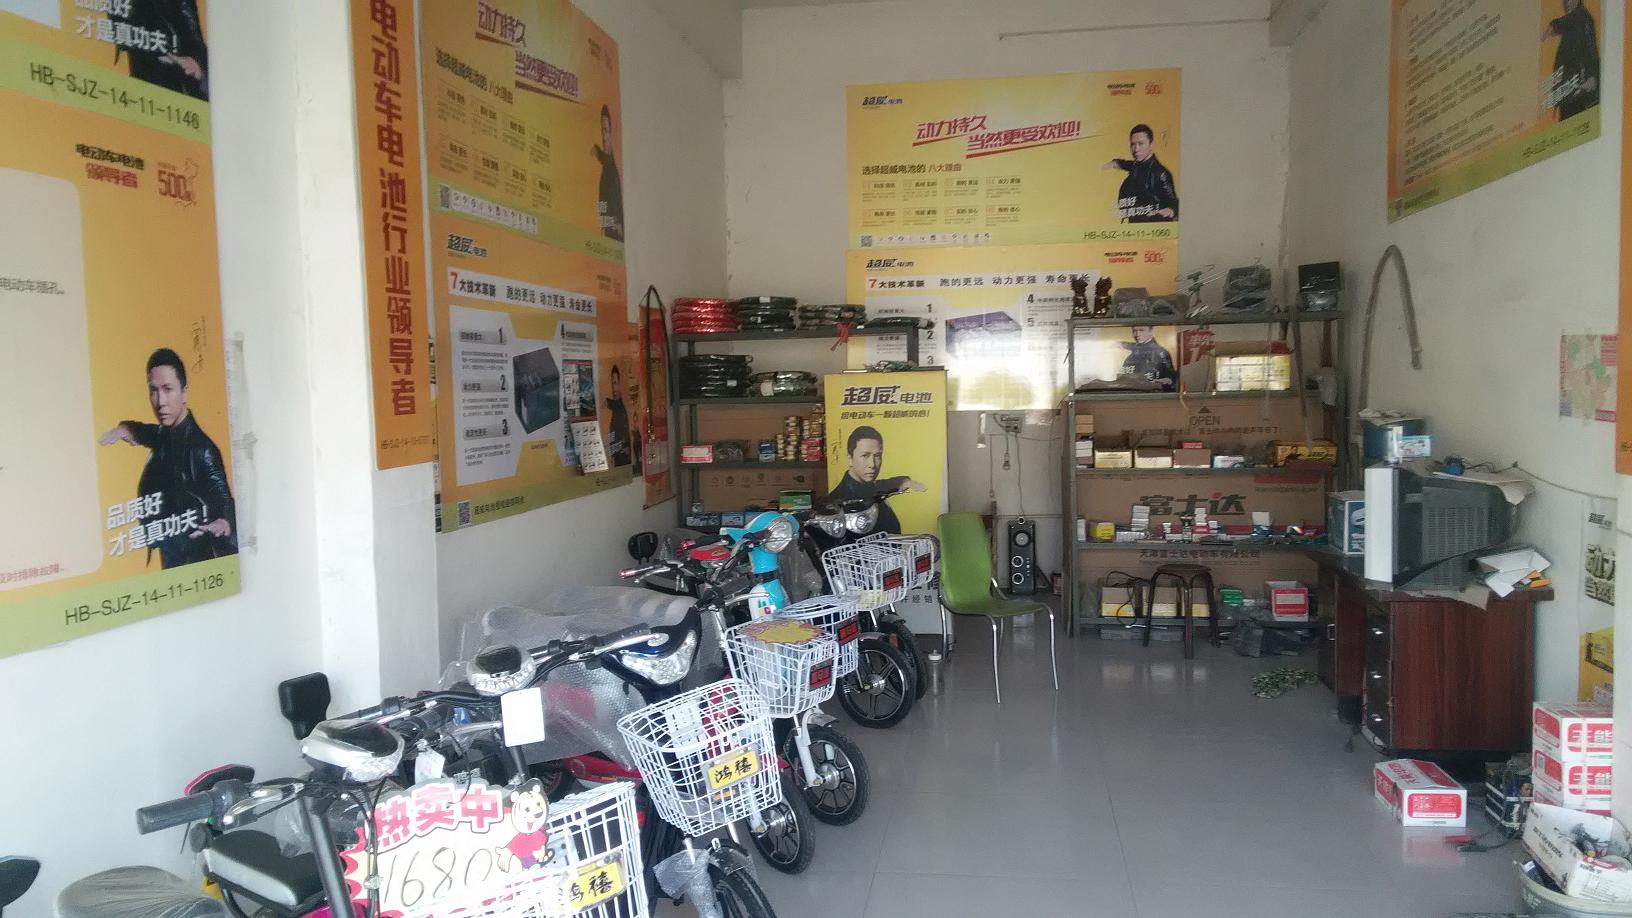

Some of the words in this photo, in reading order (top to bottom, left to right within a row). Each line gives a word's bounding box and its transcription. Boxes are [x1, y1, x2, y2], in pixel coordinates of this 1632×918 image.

[916, 115, 988, 140] 动力持久
[967, 120, 1082, 151] 当然更受欢迎!
[370, 0, 417, 416] 电动车电池行业领导者
[939, 276, 984, 287] 跑的更远
[992, 275, 1037, 285] 动力更强
[1189, 415, 1221, 426] OPEN
[106, 492, 164, 530] 品质好
[109, 506, 209, 557] 才是真功夫!
[374, 785, 499, 847] 热卖中
